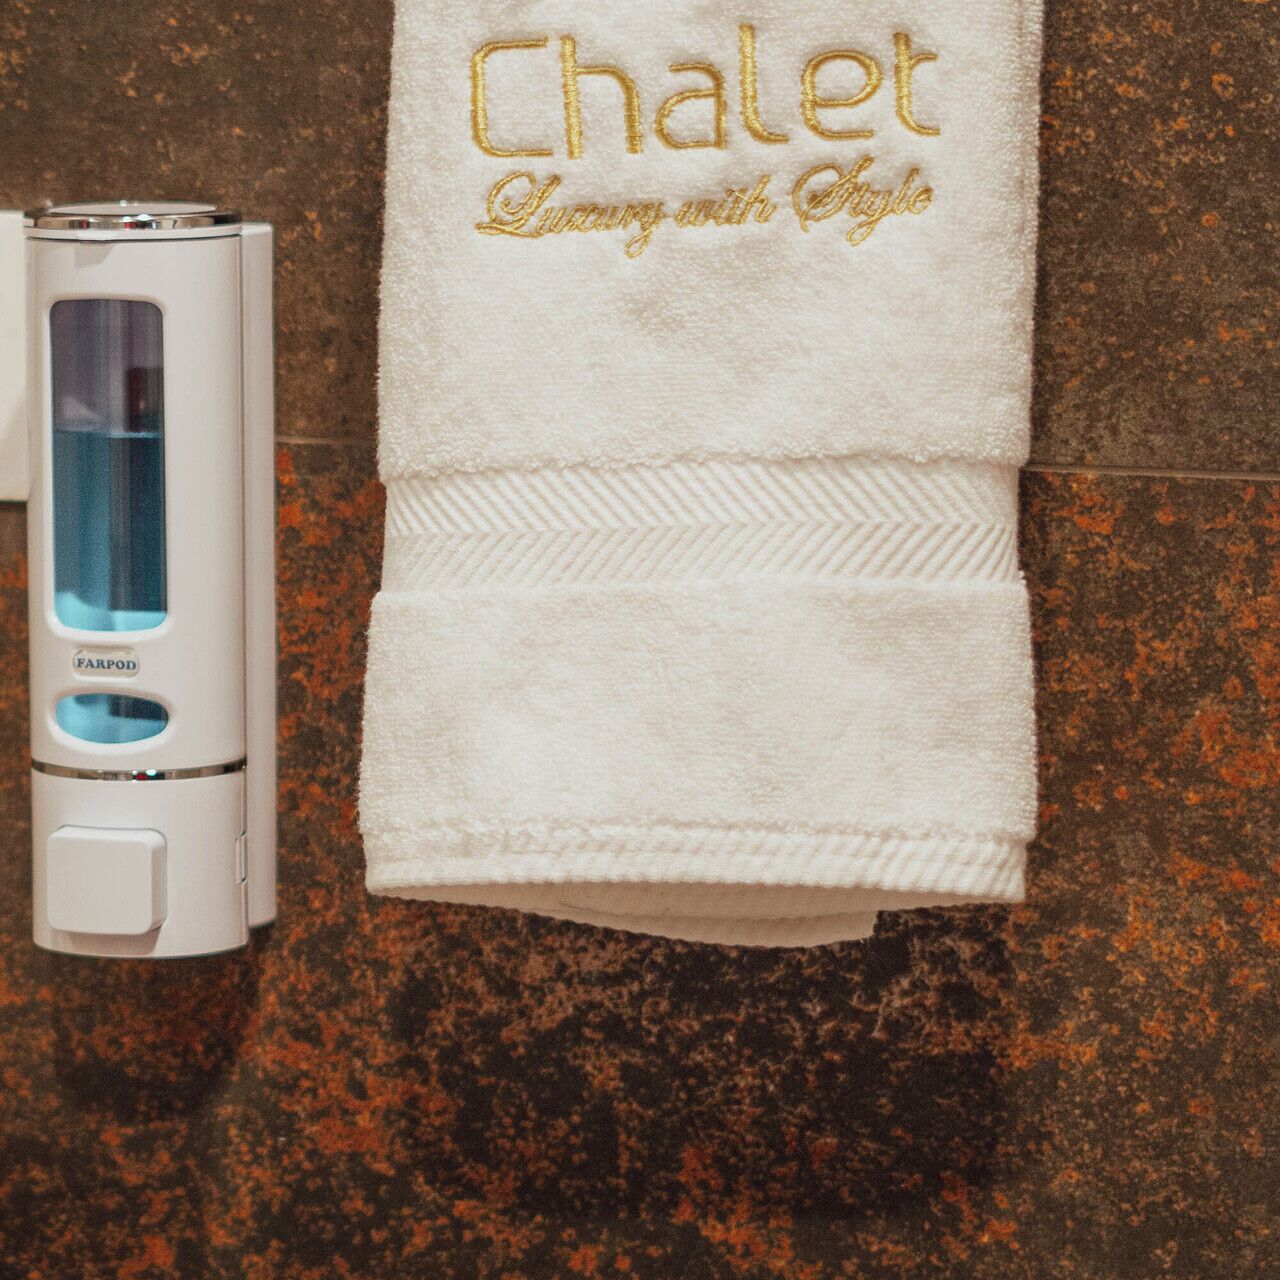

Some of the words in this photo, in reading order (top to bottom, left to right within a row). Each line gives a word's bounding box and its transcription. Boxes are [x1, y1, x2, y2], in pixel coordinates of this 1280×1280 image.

[471, 23, 940, 160] Chalet
[475, 169, 664, 259] Luxury
[674, 173, 778, 229] with
[791, 154, 934, 247] Style
[76, 658, 137, 670] FARPOD
